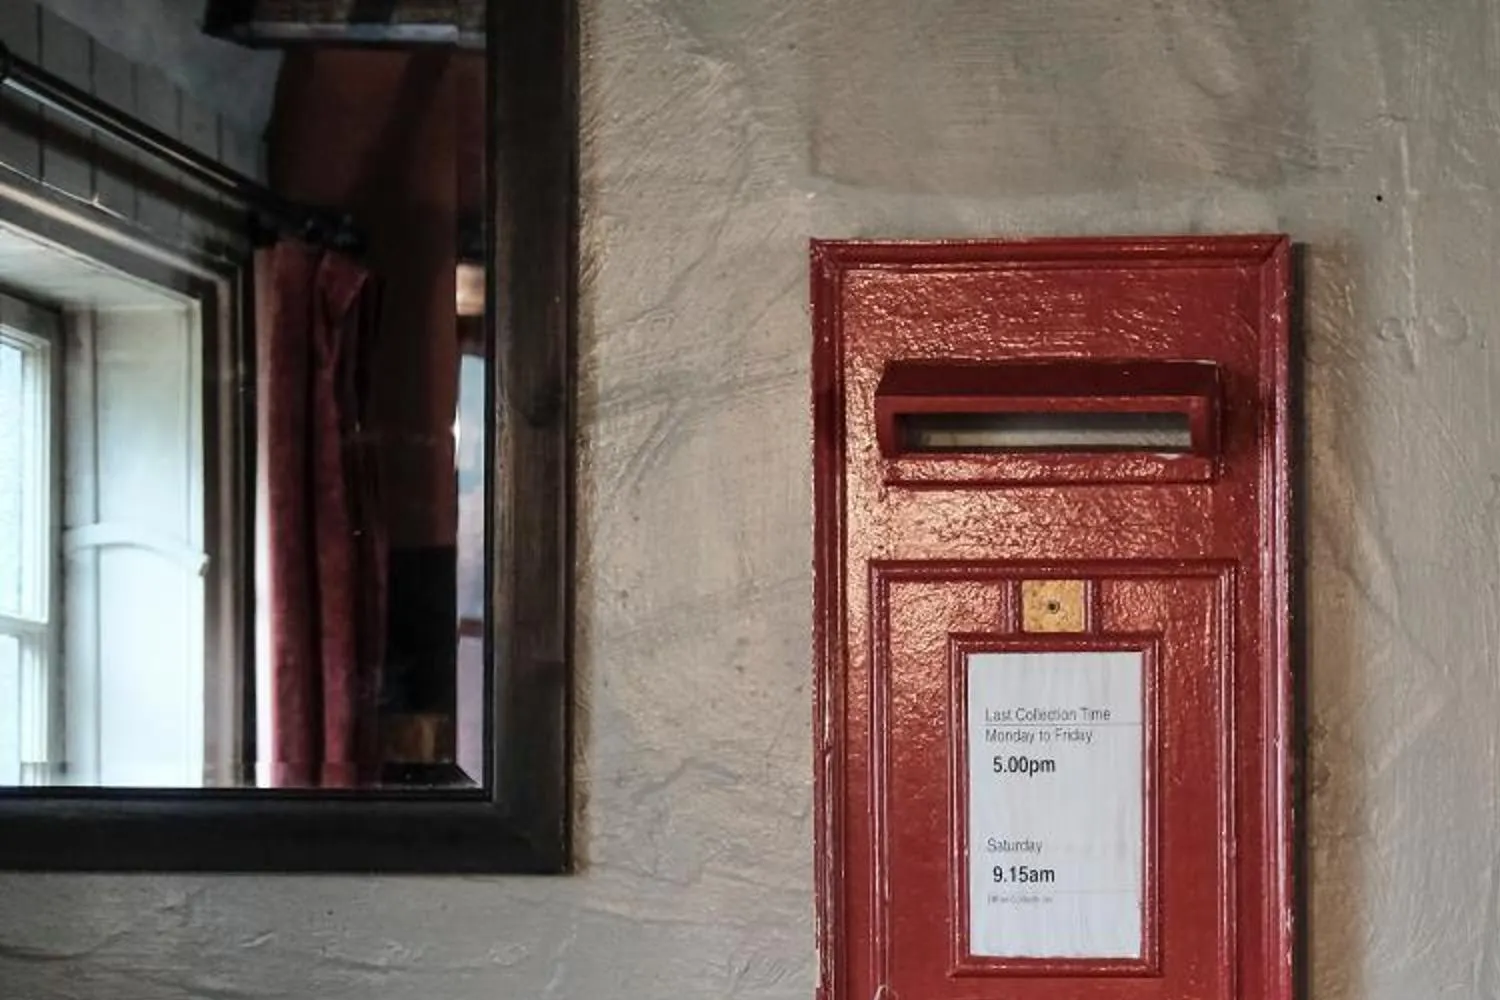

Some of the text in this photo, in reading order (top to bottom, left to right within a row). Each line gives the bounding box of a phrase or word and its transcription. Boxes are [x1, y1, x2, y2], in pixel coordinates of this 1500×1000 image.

[985, 707, 1111, 722] Last Collection Time
[985, 728, 1093, 744] Monday to Friday
[993, 755, 1056, 777] 5.00pm
[987, 838, 1042, 854] Saturday
[993, 865, 1055, 883] 9.15am
